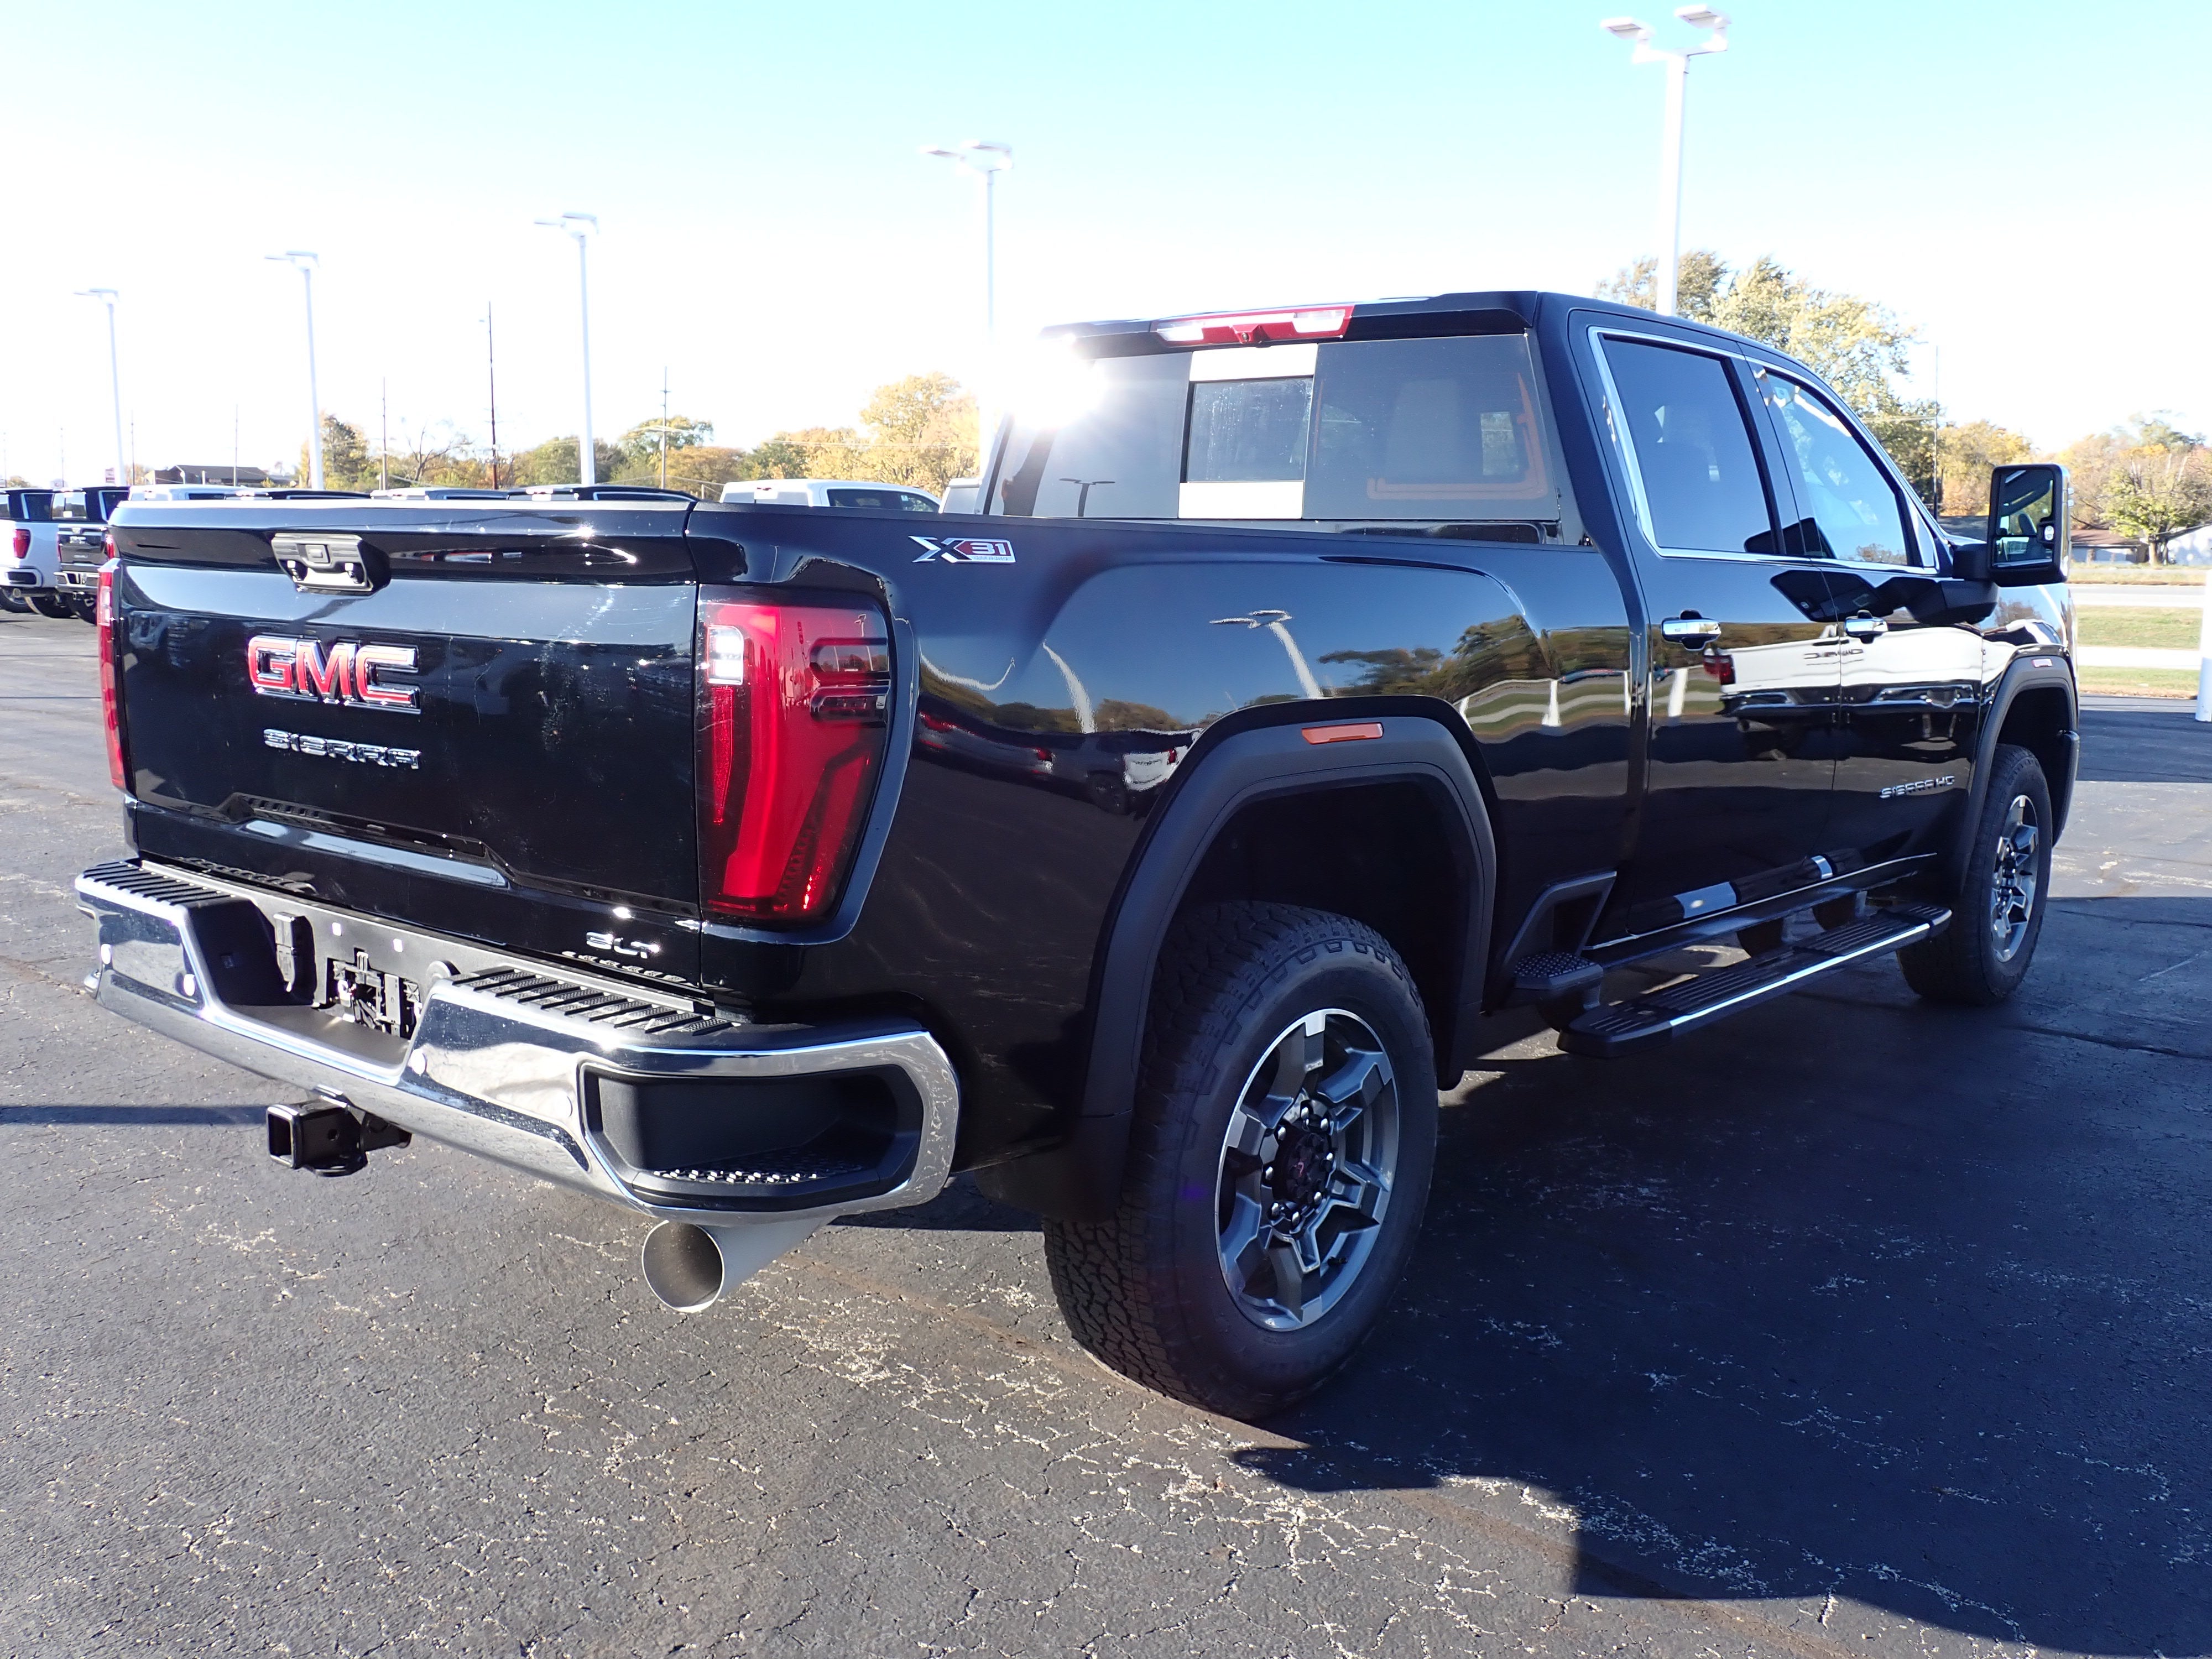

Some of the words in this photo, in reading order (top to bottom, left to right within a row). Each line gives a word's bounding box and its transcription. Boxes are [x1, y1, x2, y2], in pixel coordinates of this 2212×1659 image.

[908, 535, 1016, 563] X31
[248, 635, 421, 714] GMC
[263, 728, 420, 769] SIERRA
[1880, 779, 1934, 799] SIERRA
[1936, 775, 1955, 786] HD
[586, 932, 660, 959] SLT
